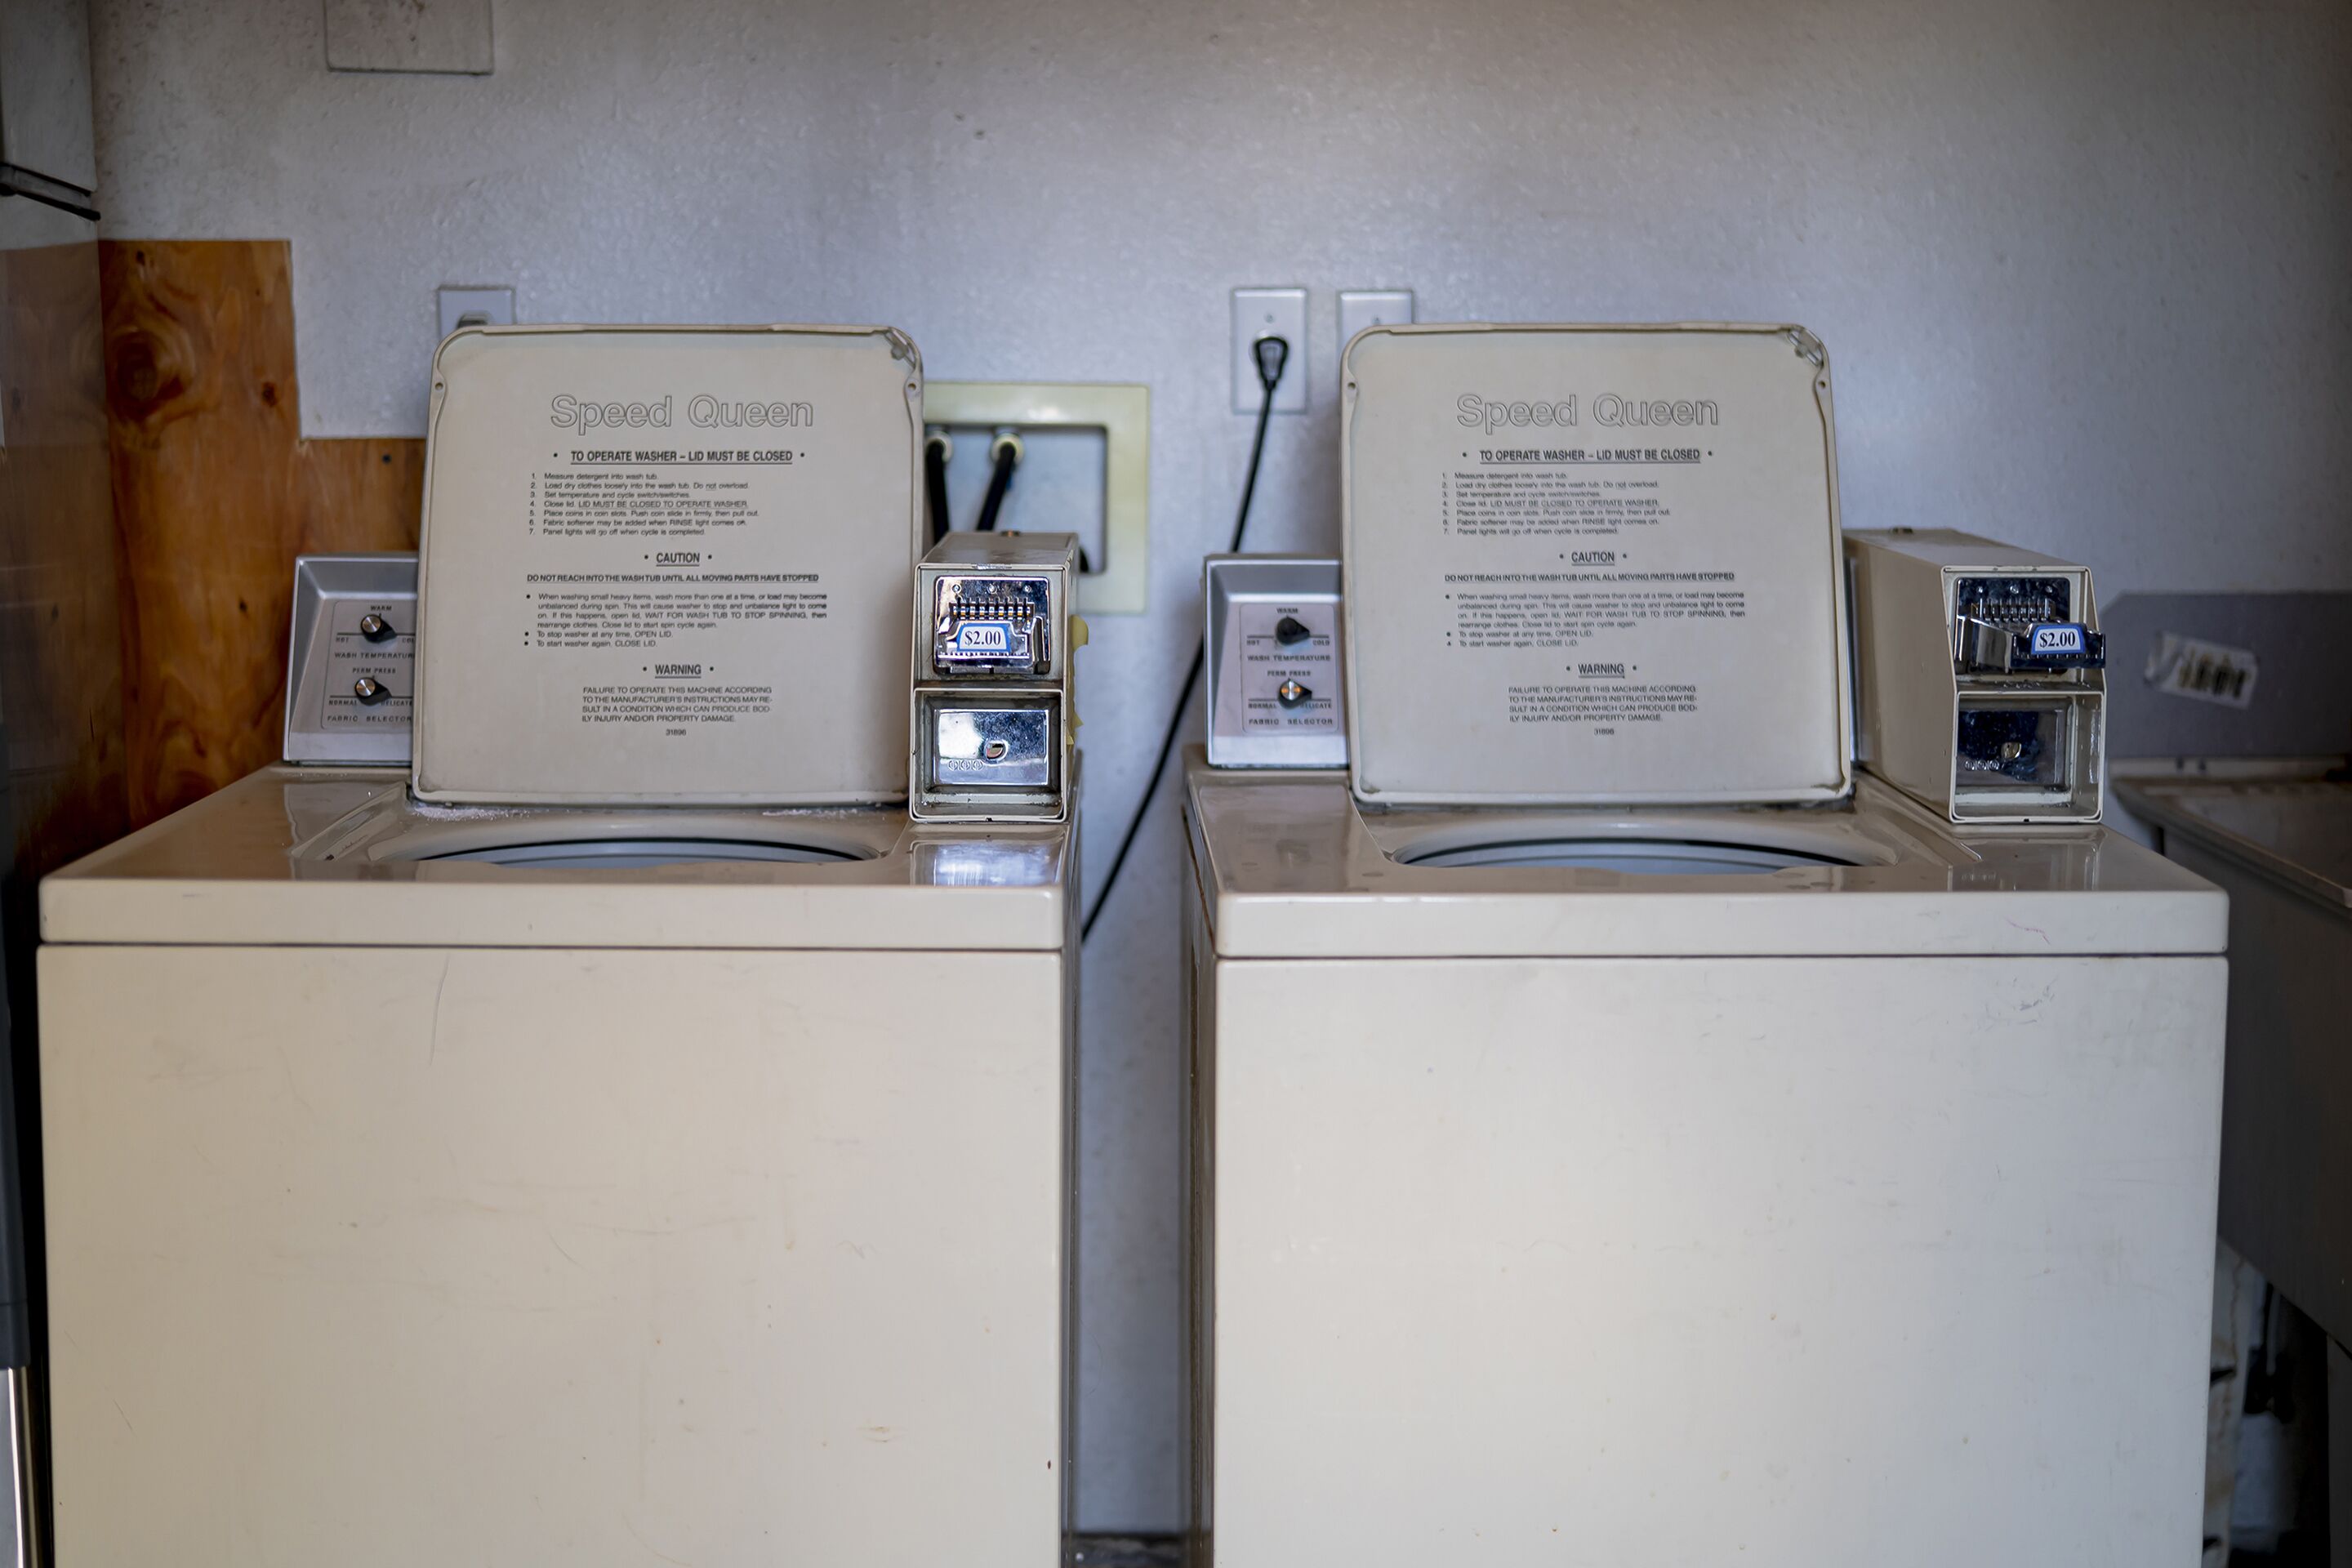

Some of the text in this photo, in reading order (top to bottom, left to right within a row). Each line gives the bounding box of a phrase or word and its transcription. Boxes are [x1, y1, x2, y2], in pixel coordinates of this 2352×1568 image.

[550, 394, 814, 436] Speed Queen
[1456, 393, 1719, 435] Speed Queen
[571, 451, 585, 462] TO
[586, 451, 633, 462] OPERATE
[635, 451, 678, 462] WASHER
[688, 451, 705, 462] LID
[706, 451, 733, 462] MUST
[736, 451, 751, 462] BE
[752, 451, 793, 462] CLOSED
[1480, 450, 1494, 461] TO
[1495, 450, 1541, 461] OPERATE
[1543, 450, 1585, 461] WASHER
[1596, 449, 1614, 461] LID
[1614, 449, 1642, 461] MUST
[1644, 449, 1659, 461] BE
[1660, 449, 1701, 461] CLOSED
[656, 552, 701, 564] CAUTION
[1571, 551, 1615, 564] CAUTION
[526, 574, 819, 582] DO NOT REACH INTO THE WASH TUB UNTIL ALL MOVING PARTS HAVE STOPPED
[1444, 572, 1735, 583] DO NOT REACH INTO THE WASH TUB UNTIL ALL MOVING PARTS HAVE STOPPED
[964, 630, 1001, 646] $2.00
[2039, 631, 2076, 648] $2.00
[654, 664, 702, 676] WARNING
[1578, 663, 1624, 675] WARNING
